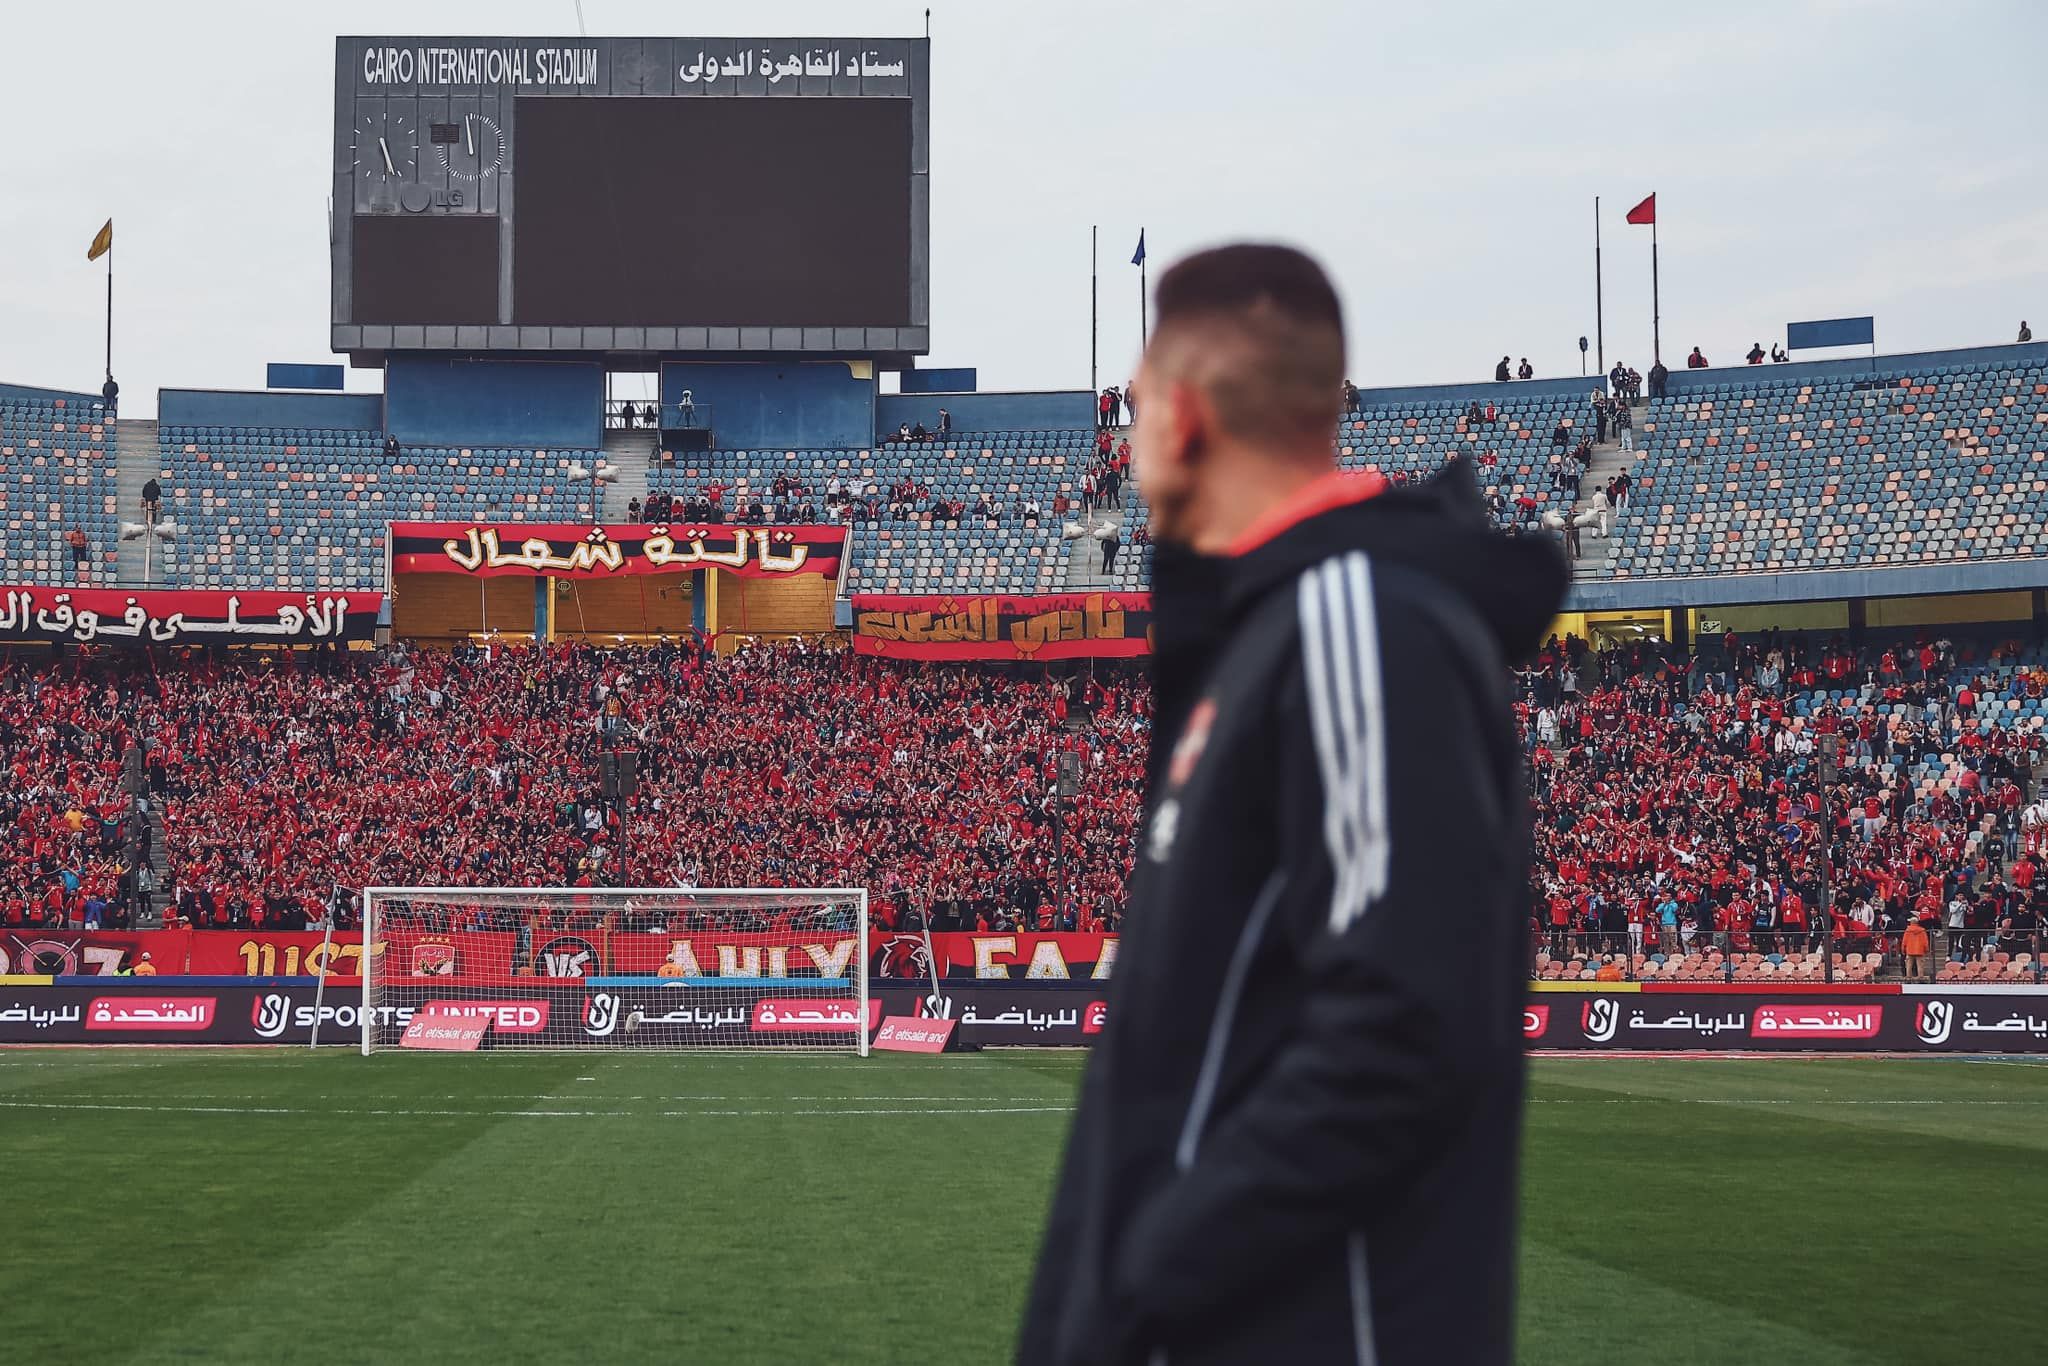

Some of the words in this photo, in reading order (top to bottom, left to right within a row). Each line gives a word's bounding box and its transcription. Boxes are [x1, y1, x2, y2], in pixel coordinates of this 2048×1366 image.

[364, 47, 414, 84] CAIRO
[417, 47, 532, 85] INTERNATIONAL
[535, 48, 598, 86] STADIUM
[759, 48, 840, 84] القاهرة
[846, 50, 904, 77] ستاد
[443, 526, 624, 572] شمال
[37, 593, 147, 641] فوق
[0, 1002, 80, 1028] للرياض
[95, 1002, 205, 1022] المتحدة
[295, 1006, 416, 1027] SPORTS
[961, 1005, 1077, 1031] للرياضة
[1629, 1009, 1745, 1036] للرياضة
[1759, 1010, 1871, 1031] المتحدة
[1963, 1012, 2047, 1038] ياضة
